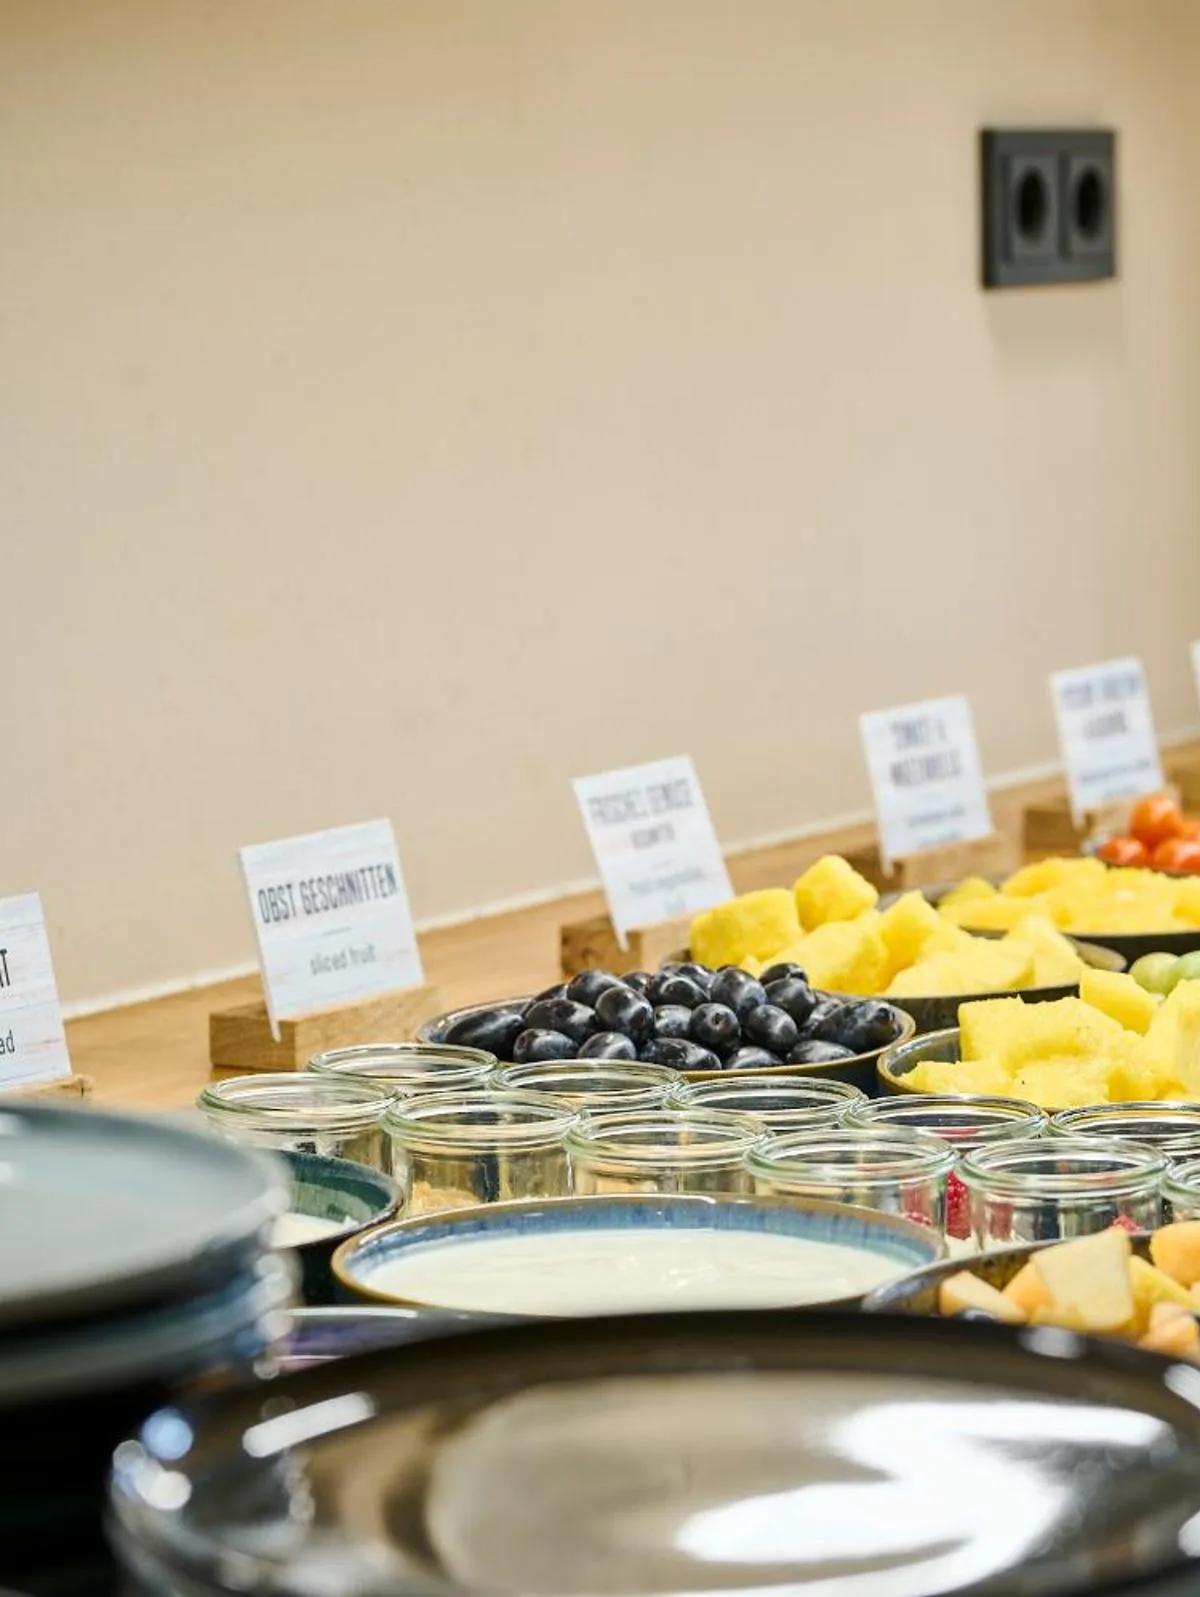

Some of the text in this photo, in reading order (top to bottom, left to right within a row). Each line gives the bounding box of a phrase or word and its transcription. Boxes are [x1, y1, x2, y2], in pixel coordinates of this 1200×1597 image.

[257, 861, 398, 925] OBST GESCHNITTEN
[309, 943, 376, 976] sliced fruit
